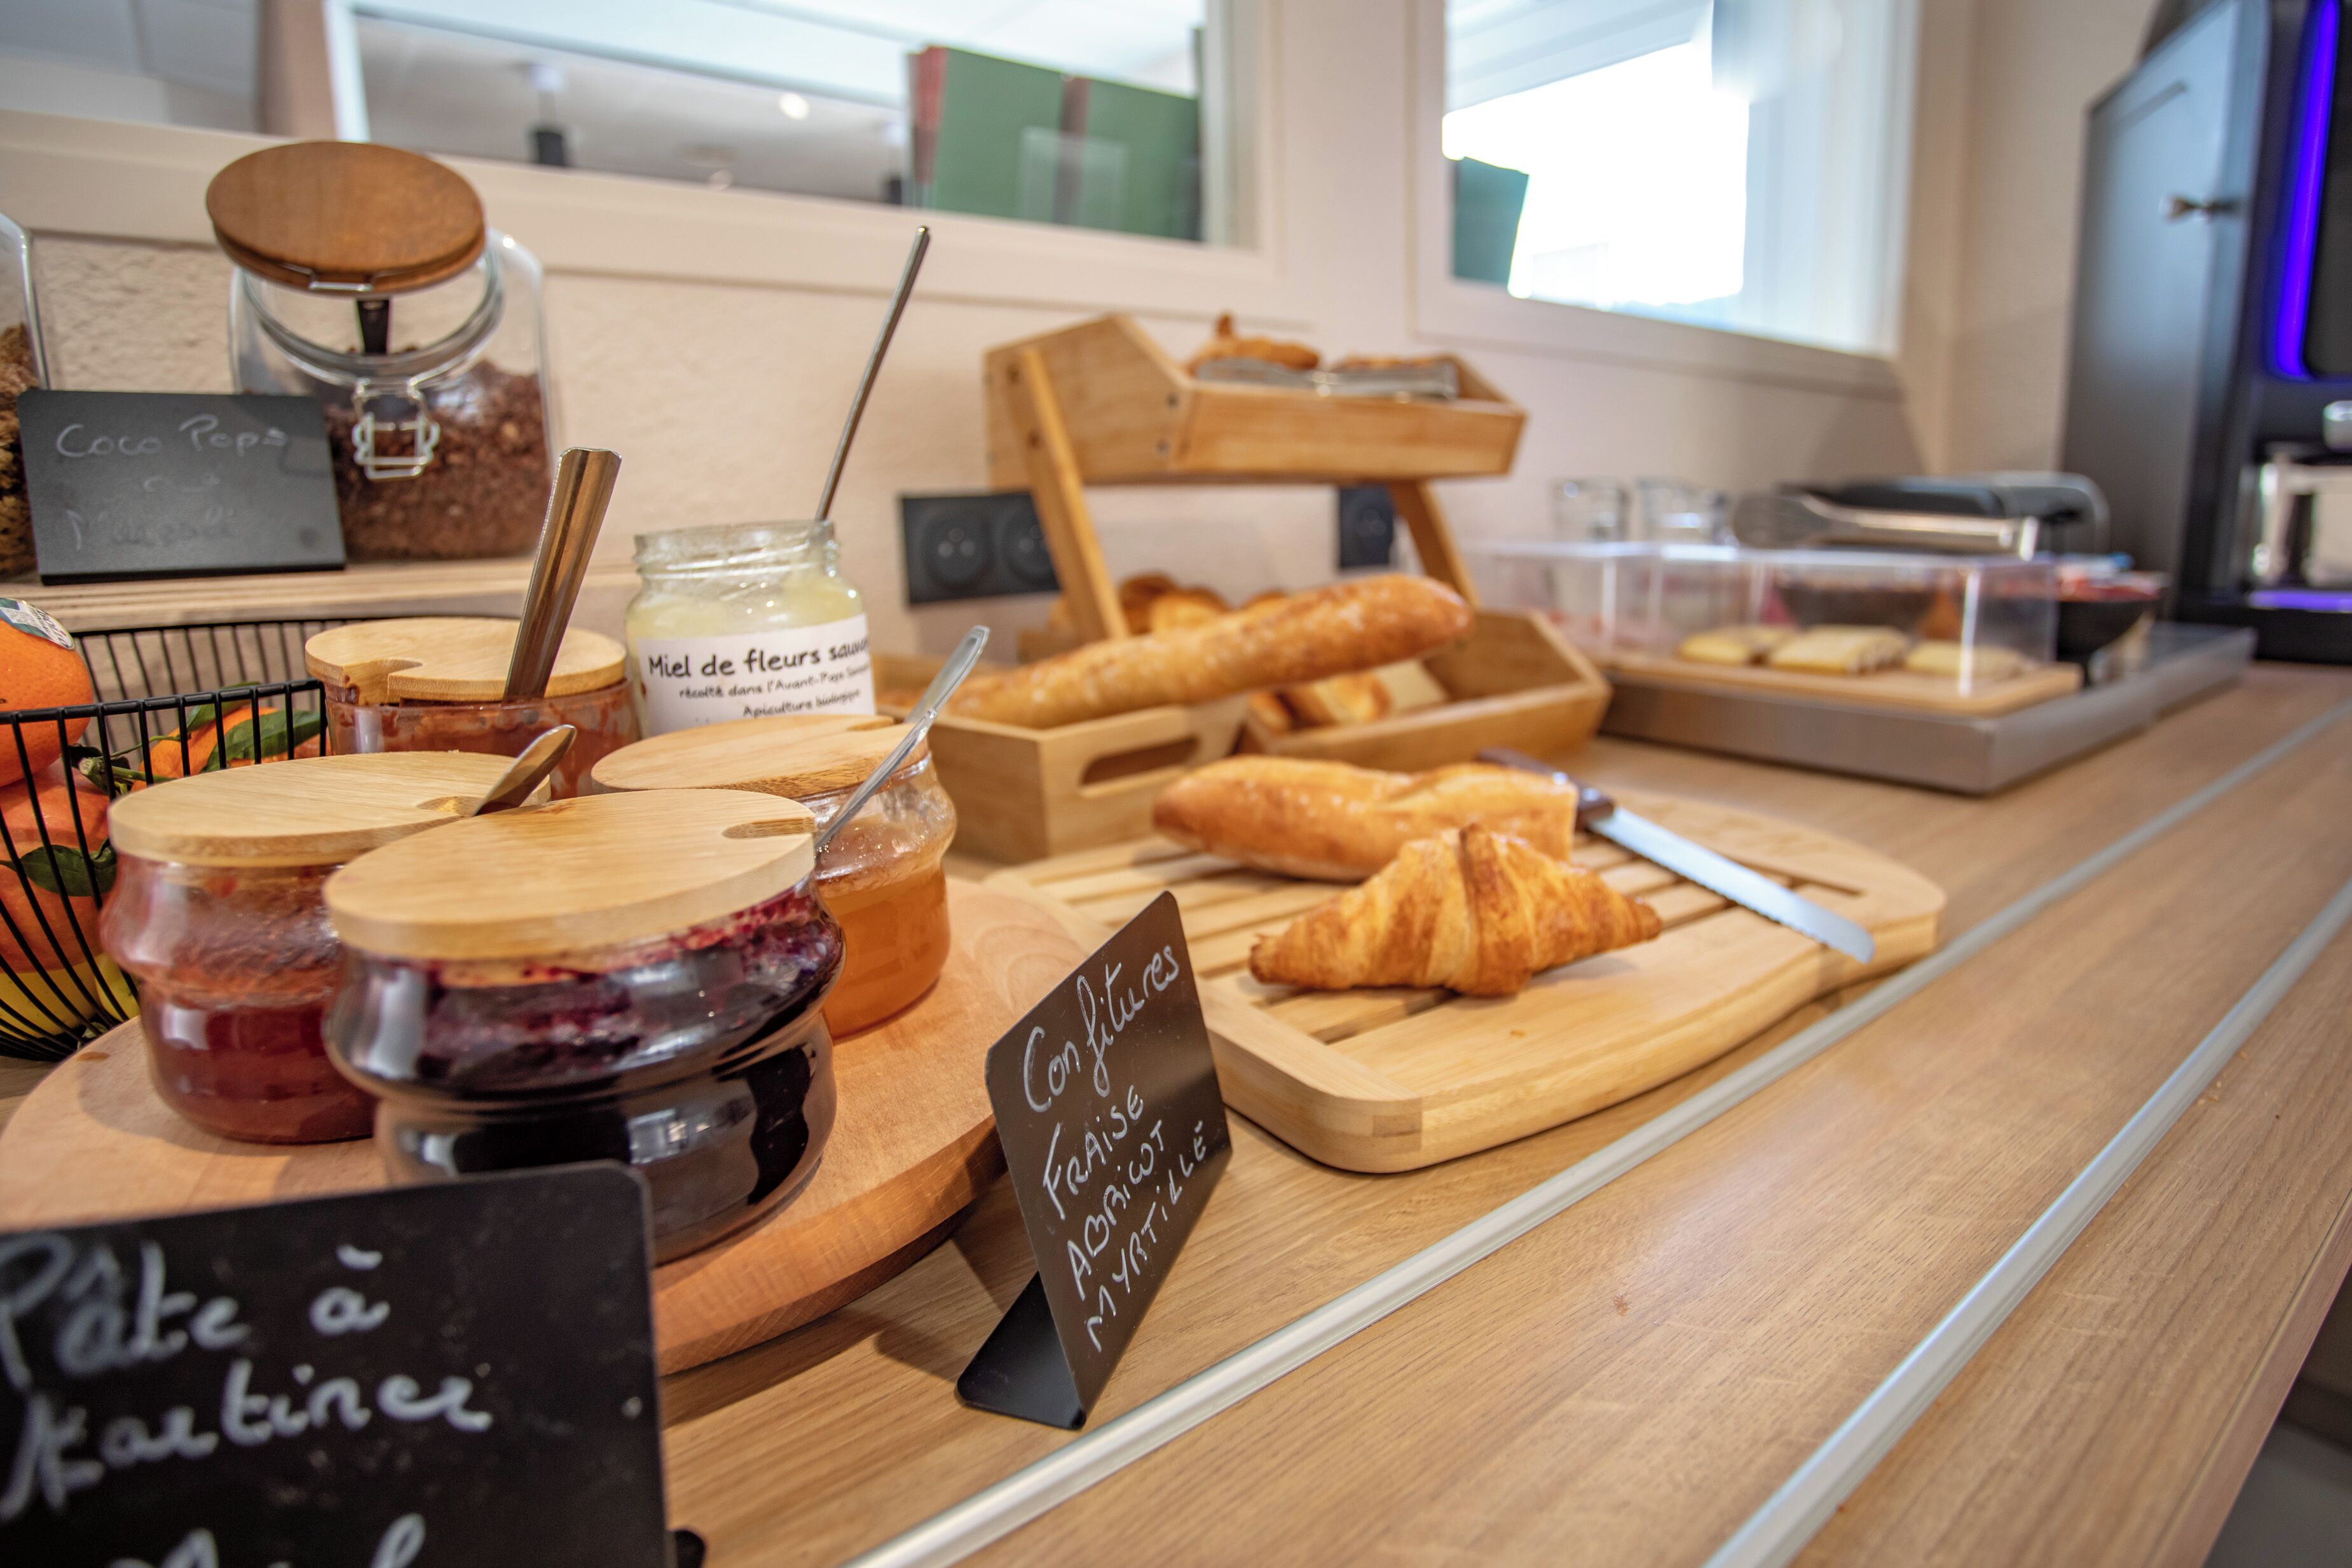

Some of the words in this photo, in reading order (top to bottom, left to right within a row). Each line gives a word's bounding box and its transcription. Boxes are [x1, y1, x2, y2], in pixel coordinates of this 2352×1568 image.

[56, 423, 163, 458] Coco
[648, 654, 692, 678] Miel
[700, 654, 735, 676] de
[742, 647, 821, 674] fleurs
[728, 684, 763, 697] dans
[742, 699, 813, 719] Apiculture
[1023, 944, 1180, 1114] Confitures
